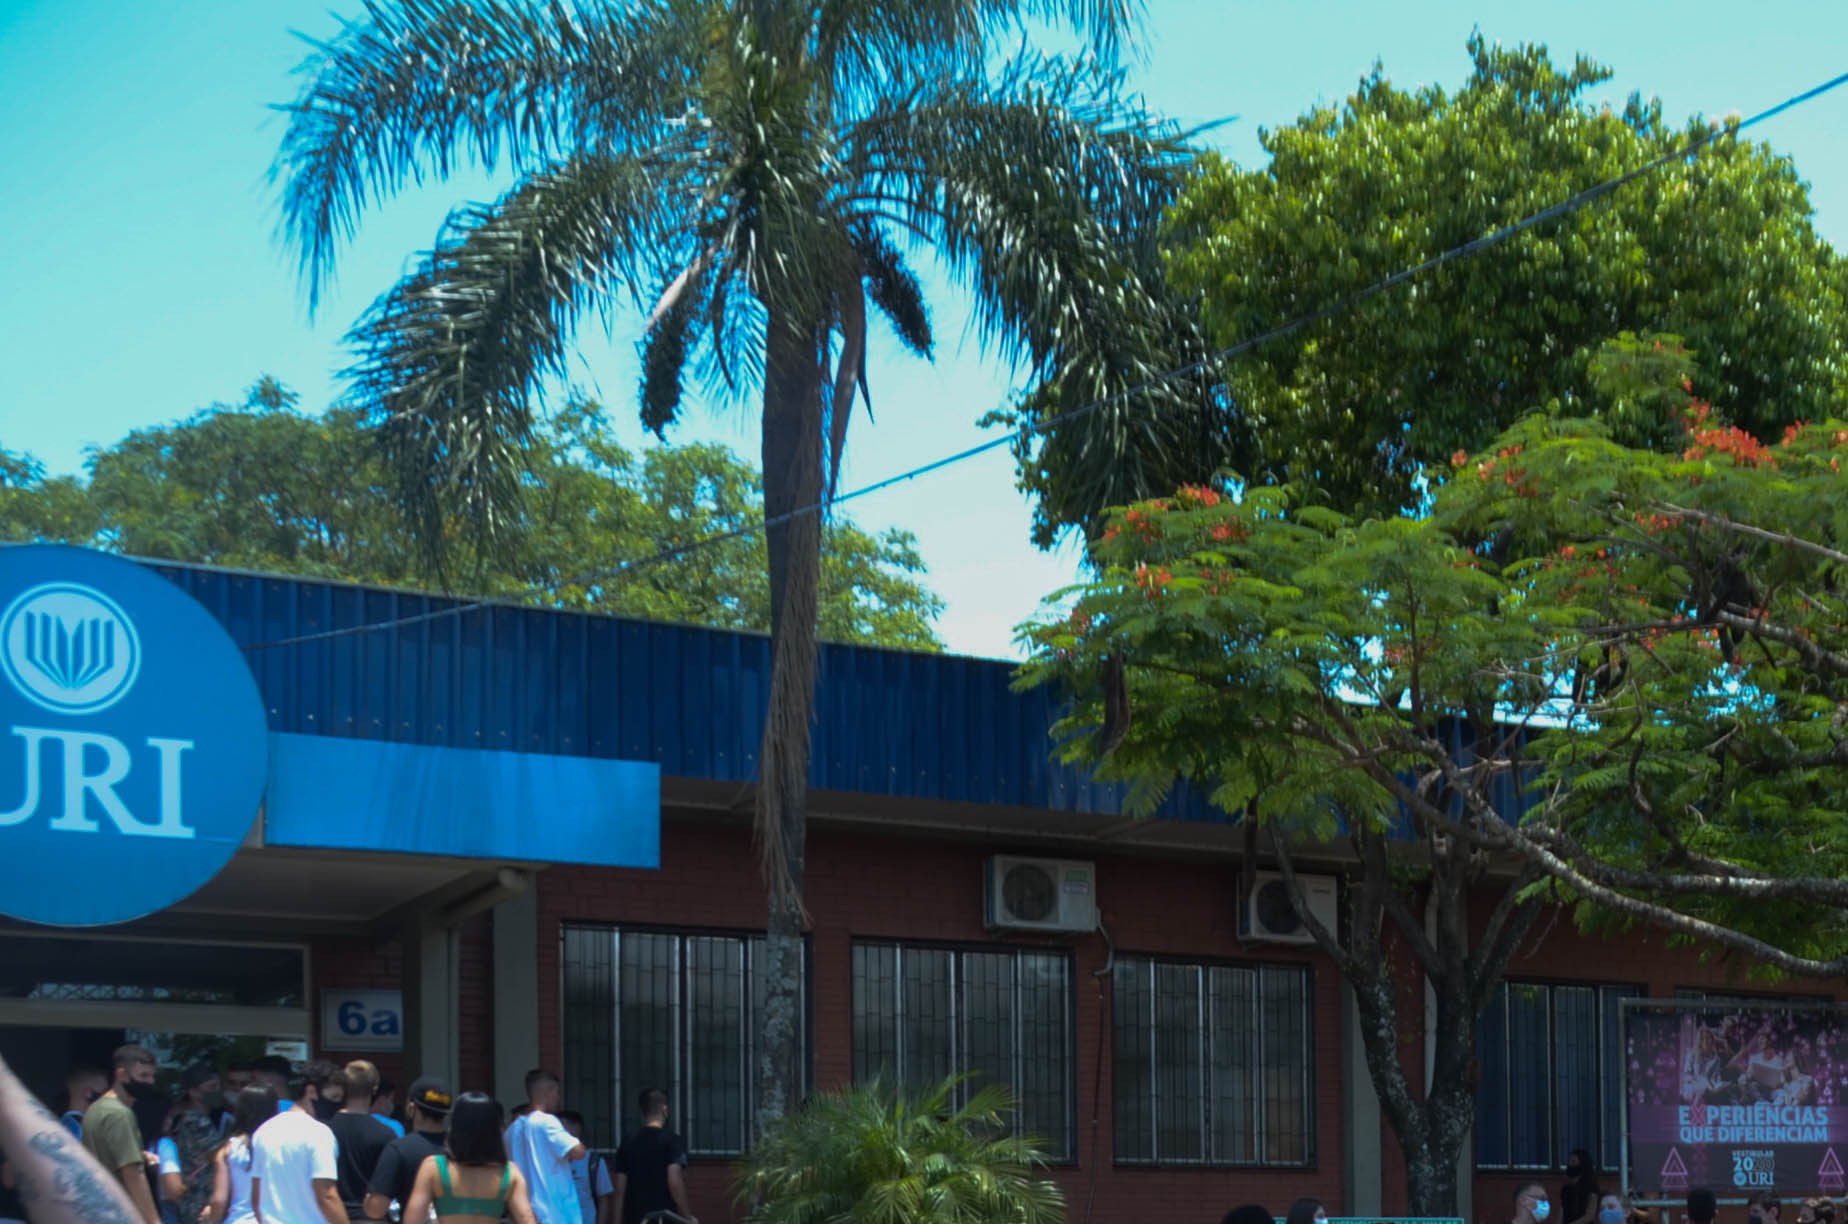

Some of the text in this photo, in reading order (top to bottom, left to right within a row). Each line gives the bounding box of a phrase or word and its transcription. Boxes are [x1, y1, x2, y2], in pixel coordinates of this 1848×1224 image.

[338, 1001, 399, 1036] 6a
[1679, 1101, 1829, 1125] EXPERIÊNCIAS
[1680, 1126, 1828, 1143] QUE DIFERENCIAM
[1749, 1171, 1774, 1185] URI
